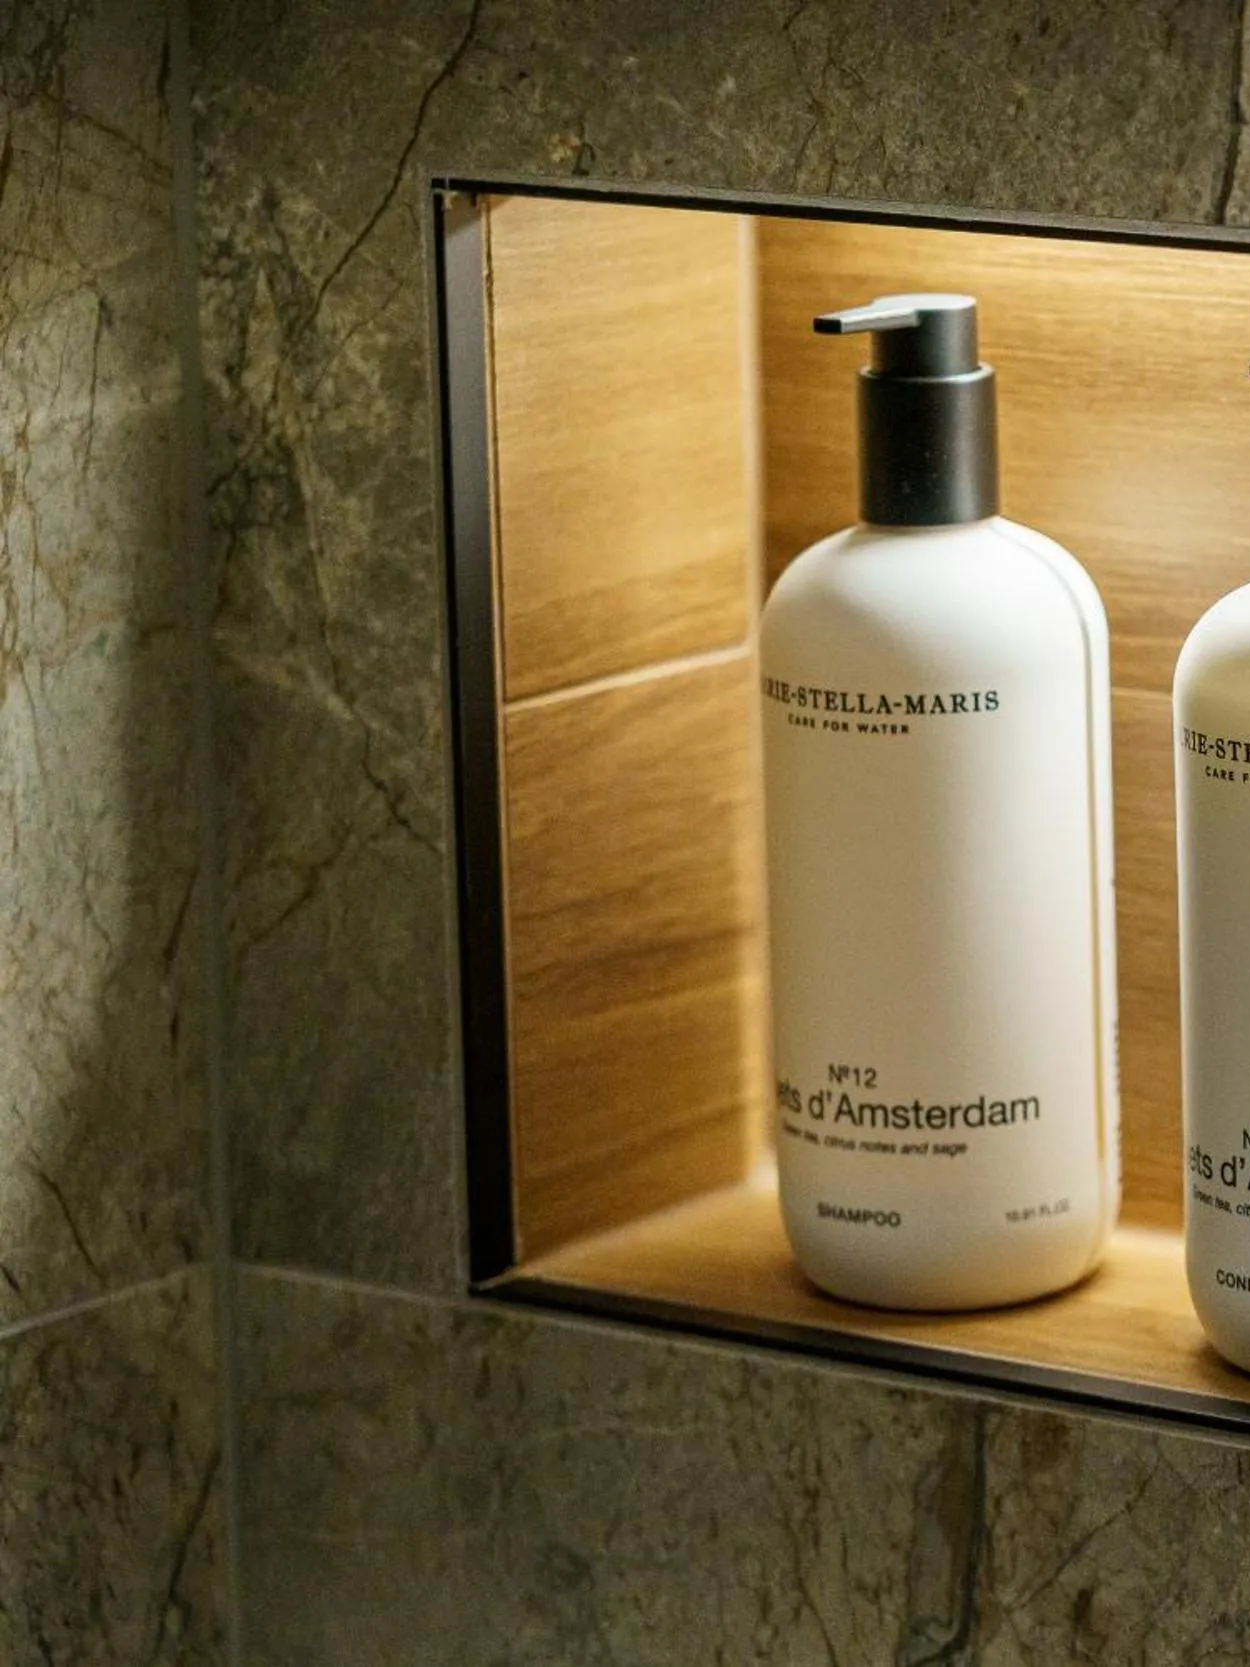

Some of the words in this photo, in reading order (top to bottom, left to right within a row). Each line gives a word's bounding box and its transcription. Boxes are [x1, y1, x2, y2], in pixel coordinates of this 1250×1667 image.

[822, 719, 849, 733] FOR
[857, 722, 910, 735] WATER
[1205, 766, 1235, 782] CARE
[817, 1202, 901, 1228] SHAMPOO
